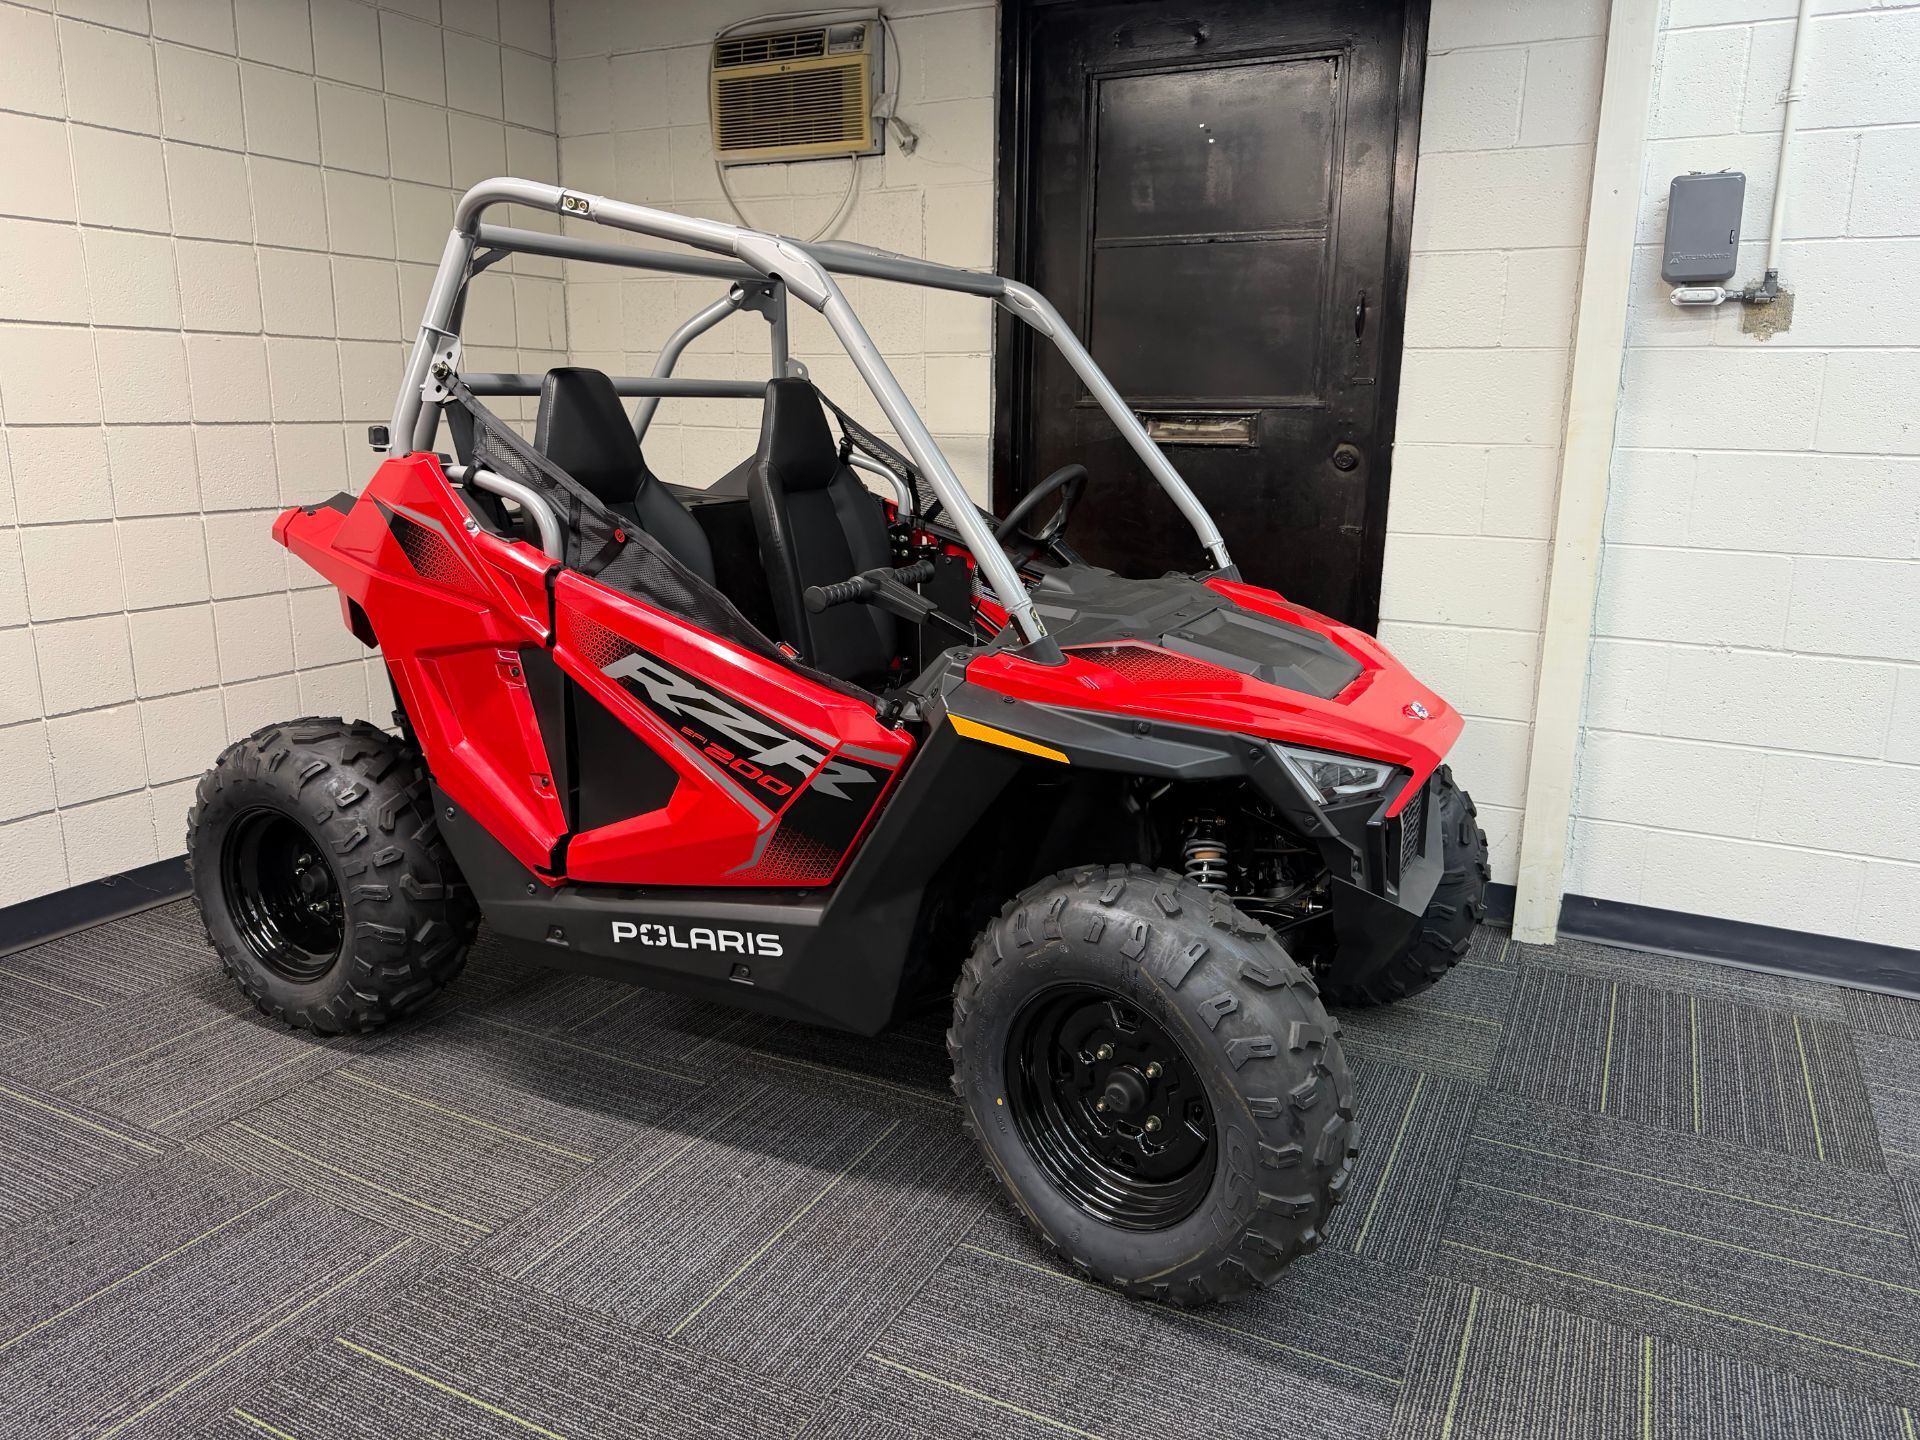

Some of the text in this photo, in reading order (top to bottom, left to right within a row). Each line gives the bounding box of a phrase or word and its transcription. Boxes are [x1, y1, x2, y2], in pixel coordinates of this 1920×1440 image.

[600, 653, 877, 801] RZR
[681, 726, 793, 796] EFI 200
[612, 921, 784, 957] POLARIS
